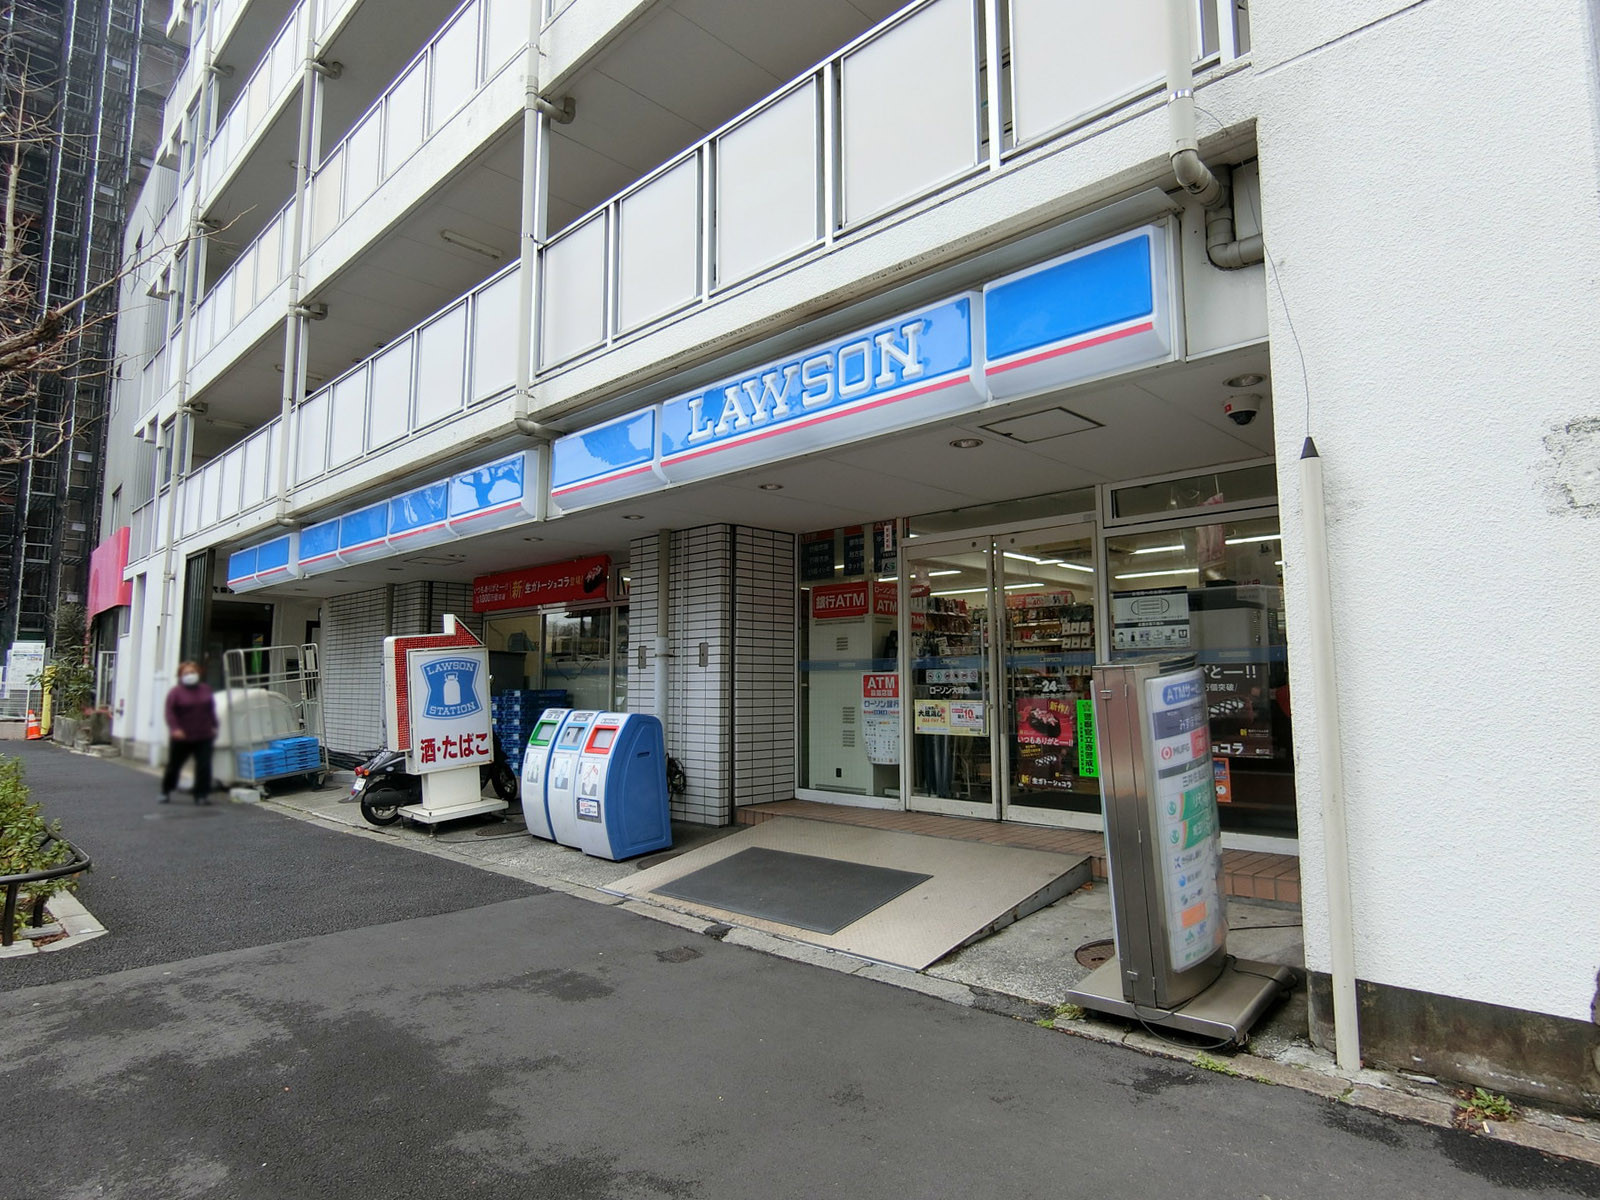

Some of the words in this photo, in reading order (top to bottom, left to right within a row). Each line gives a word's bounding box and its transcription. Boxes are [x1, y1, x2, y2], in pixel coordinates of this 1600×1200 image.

[687, 319, 925, 443] LAWSON
[511, 580, 523, 600] 新
[815, 592, 865, 610] 銀行ATM
[876, 600, 897, 613] ATM
[426, 661, 475, 676] LAWSON
[867, 676, 896, 689] ATM
[1041, 680, 1058, 692] 24
[429, 701, 476, 715] STATION
[420, 732, 490, 763] 酒・たばこ
[1173, 743, 1190, 757] MUFG
